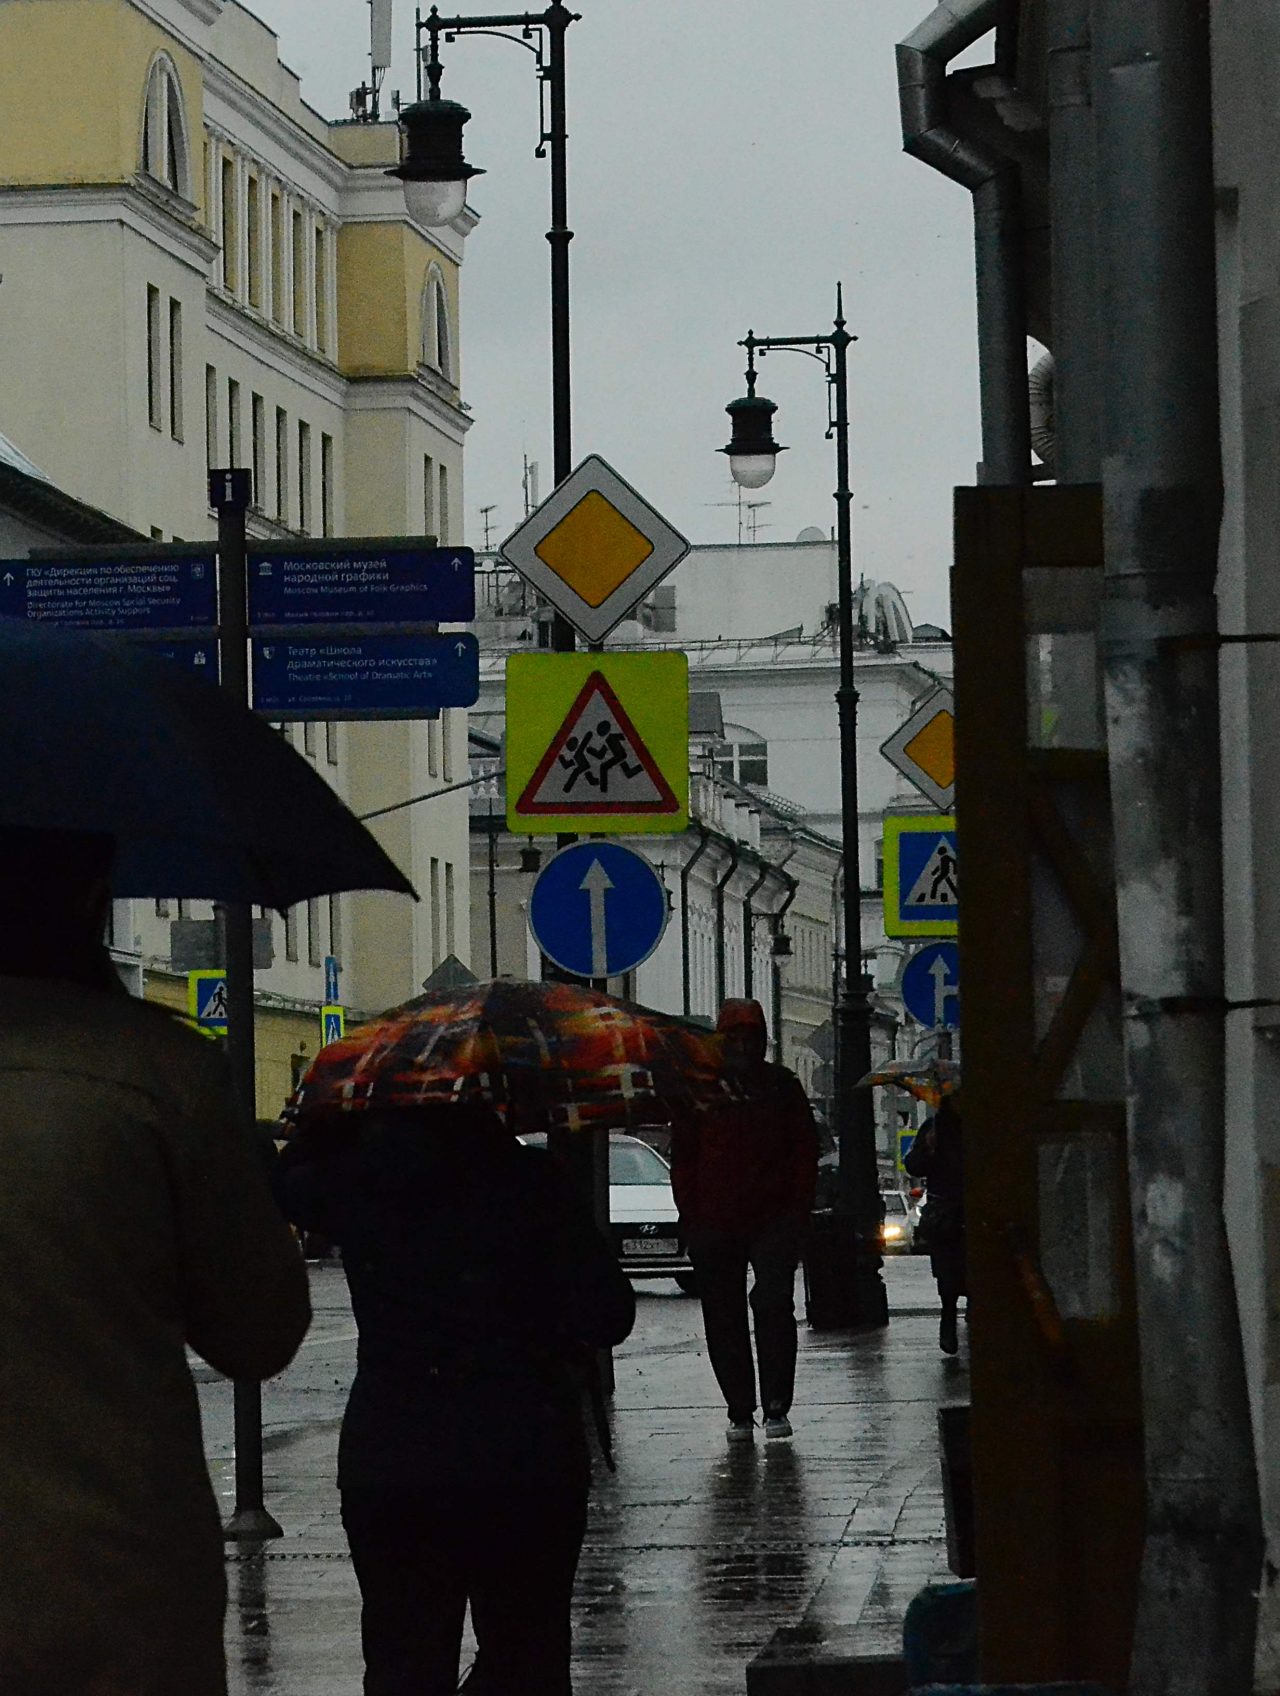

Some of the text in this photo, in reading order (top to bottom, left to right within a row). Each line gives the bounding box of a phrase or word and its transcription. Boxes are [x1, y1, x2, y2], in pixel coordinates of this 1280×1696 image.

[26, 568, 42, 577] ГКУ
[100, 567, 112, 575] по
[114, 564, 180, 574] обеспечению
[283, 558, 387, 572] Московский музей
[26, 577, 92, 588] деятельности
[94, 575, 158, 586] организаций
[283, 571, 390, 584] народной графики
[27, 587, 64, 597] защиты
[67, 585, 117, 596] населения
[127, 583, 171, 594] Москвы»
[283, 583, 429, 594] Moscow Museum of Folk Graphics
[27, 600, 74, 609] Directorate
[75, 600, 87, 608] for
[88, 598, 121, 607] Moscow
[27, 608, 84, 619] Organizations
[287, 645, 362, 657] Театр «Школа
[286, 656, 438, 671] драматического искусства»
[322, 671, 359, 681] «School
[360, 671, 370, 680] of
[412, 670, 433, 680] Art»
